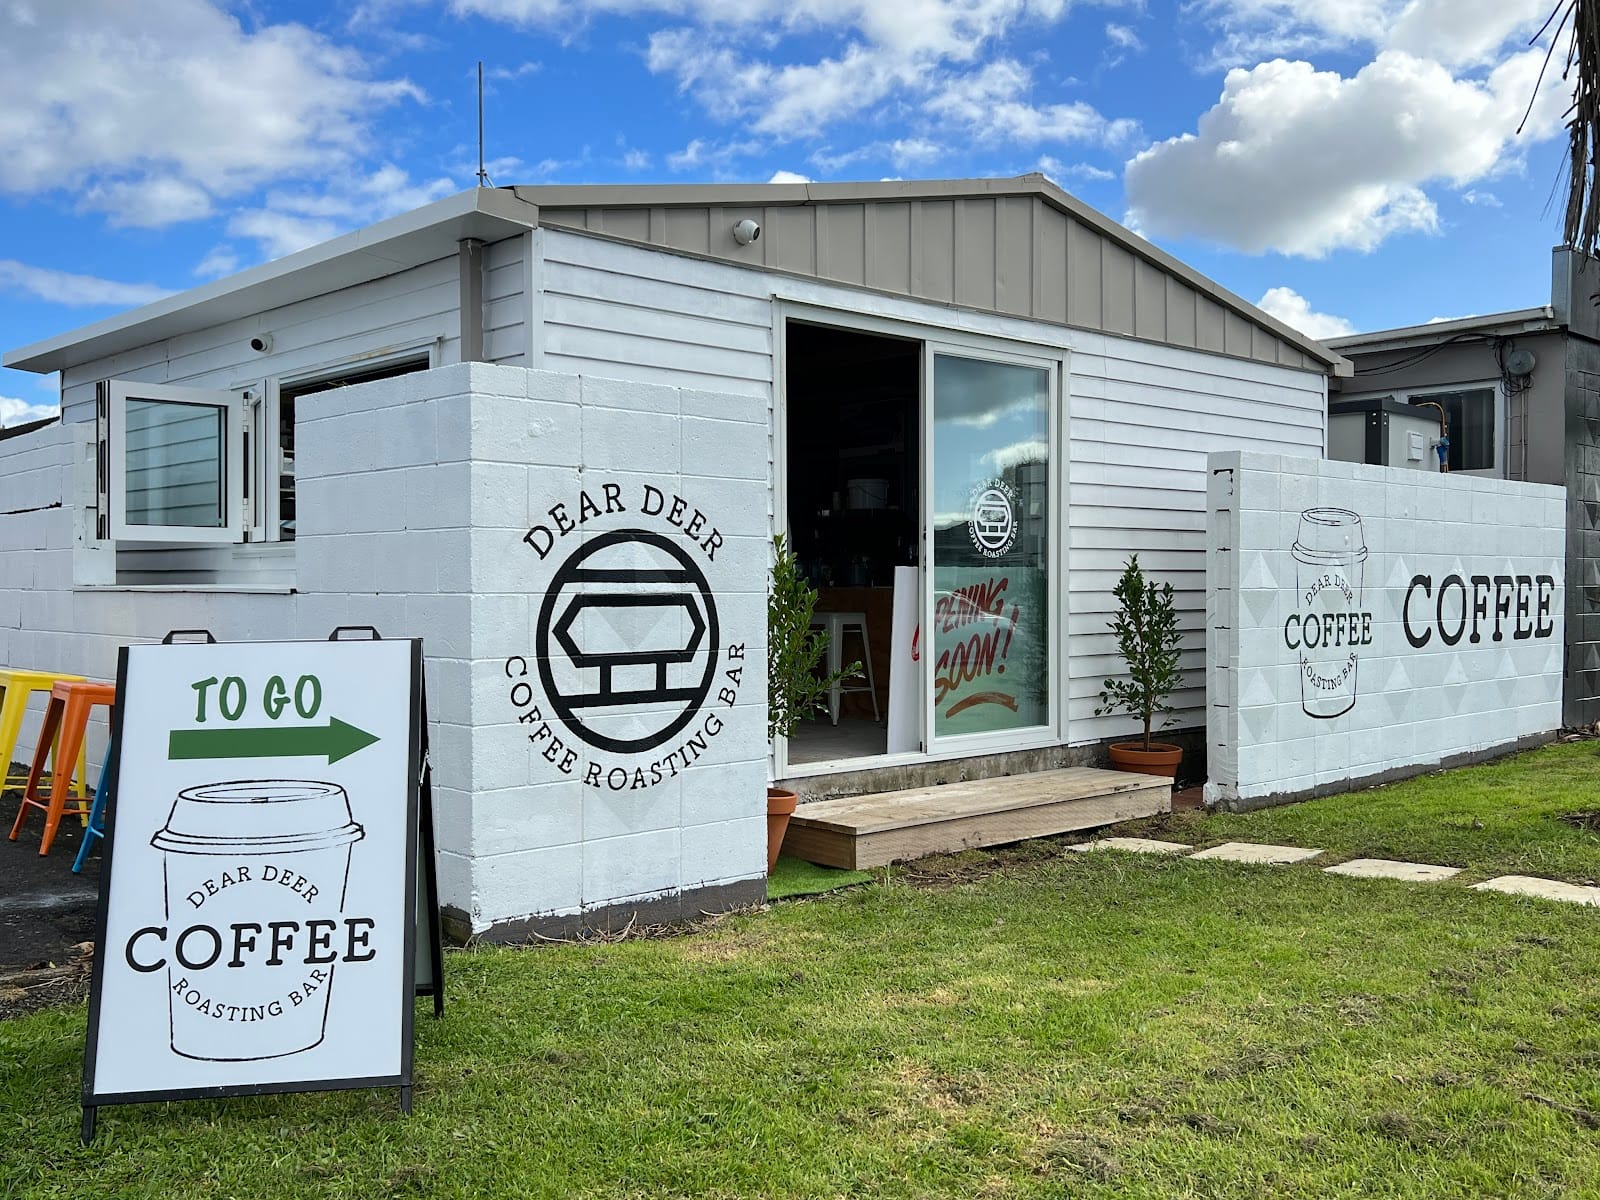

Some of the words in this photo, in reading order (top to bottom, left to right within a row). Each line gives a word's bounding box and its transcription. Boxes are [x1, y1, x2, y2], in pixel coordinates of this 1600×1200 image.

[995, 478, 1015, 499] DEER
[523, 483, 626, 560] DEAR
[641, 484, 724, 561] DEER
[968, 520, 982, 552] COFFEE
[983, 539, 1013, 558] ROASTING
[1010, 520, 1018, 539] BAR
[1305, 574, 1331, 606] DEAR
[1334, 574, 1353, 605] DEER
[1402, 574, 1555, 648] COFFEE
[934, 604, 1019, 707] SOON!
[1284, 613, 1372, 650] COFFEE
[1301, 657, 1342, 690] ROASTING
[1342, 652, 1358, 680] BAR
[191, 676, 247, 722] TO
[264, 674, 322, 720] GO
[505, 656, 578, 775] COFFEE
[584, 713, 724, 791] ROASTING
[718, 642, 745, 708] BAR
[187, 866, 252, 909] DEAR
[261, 865, 319, 904] DEER
[125, 917, 376, 973] COFFEE
[172, 977, 283, 1022] ROASTING
[288, 968, 328, 1007] BAR
